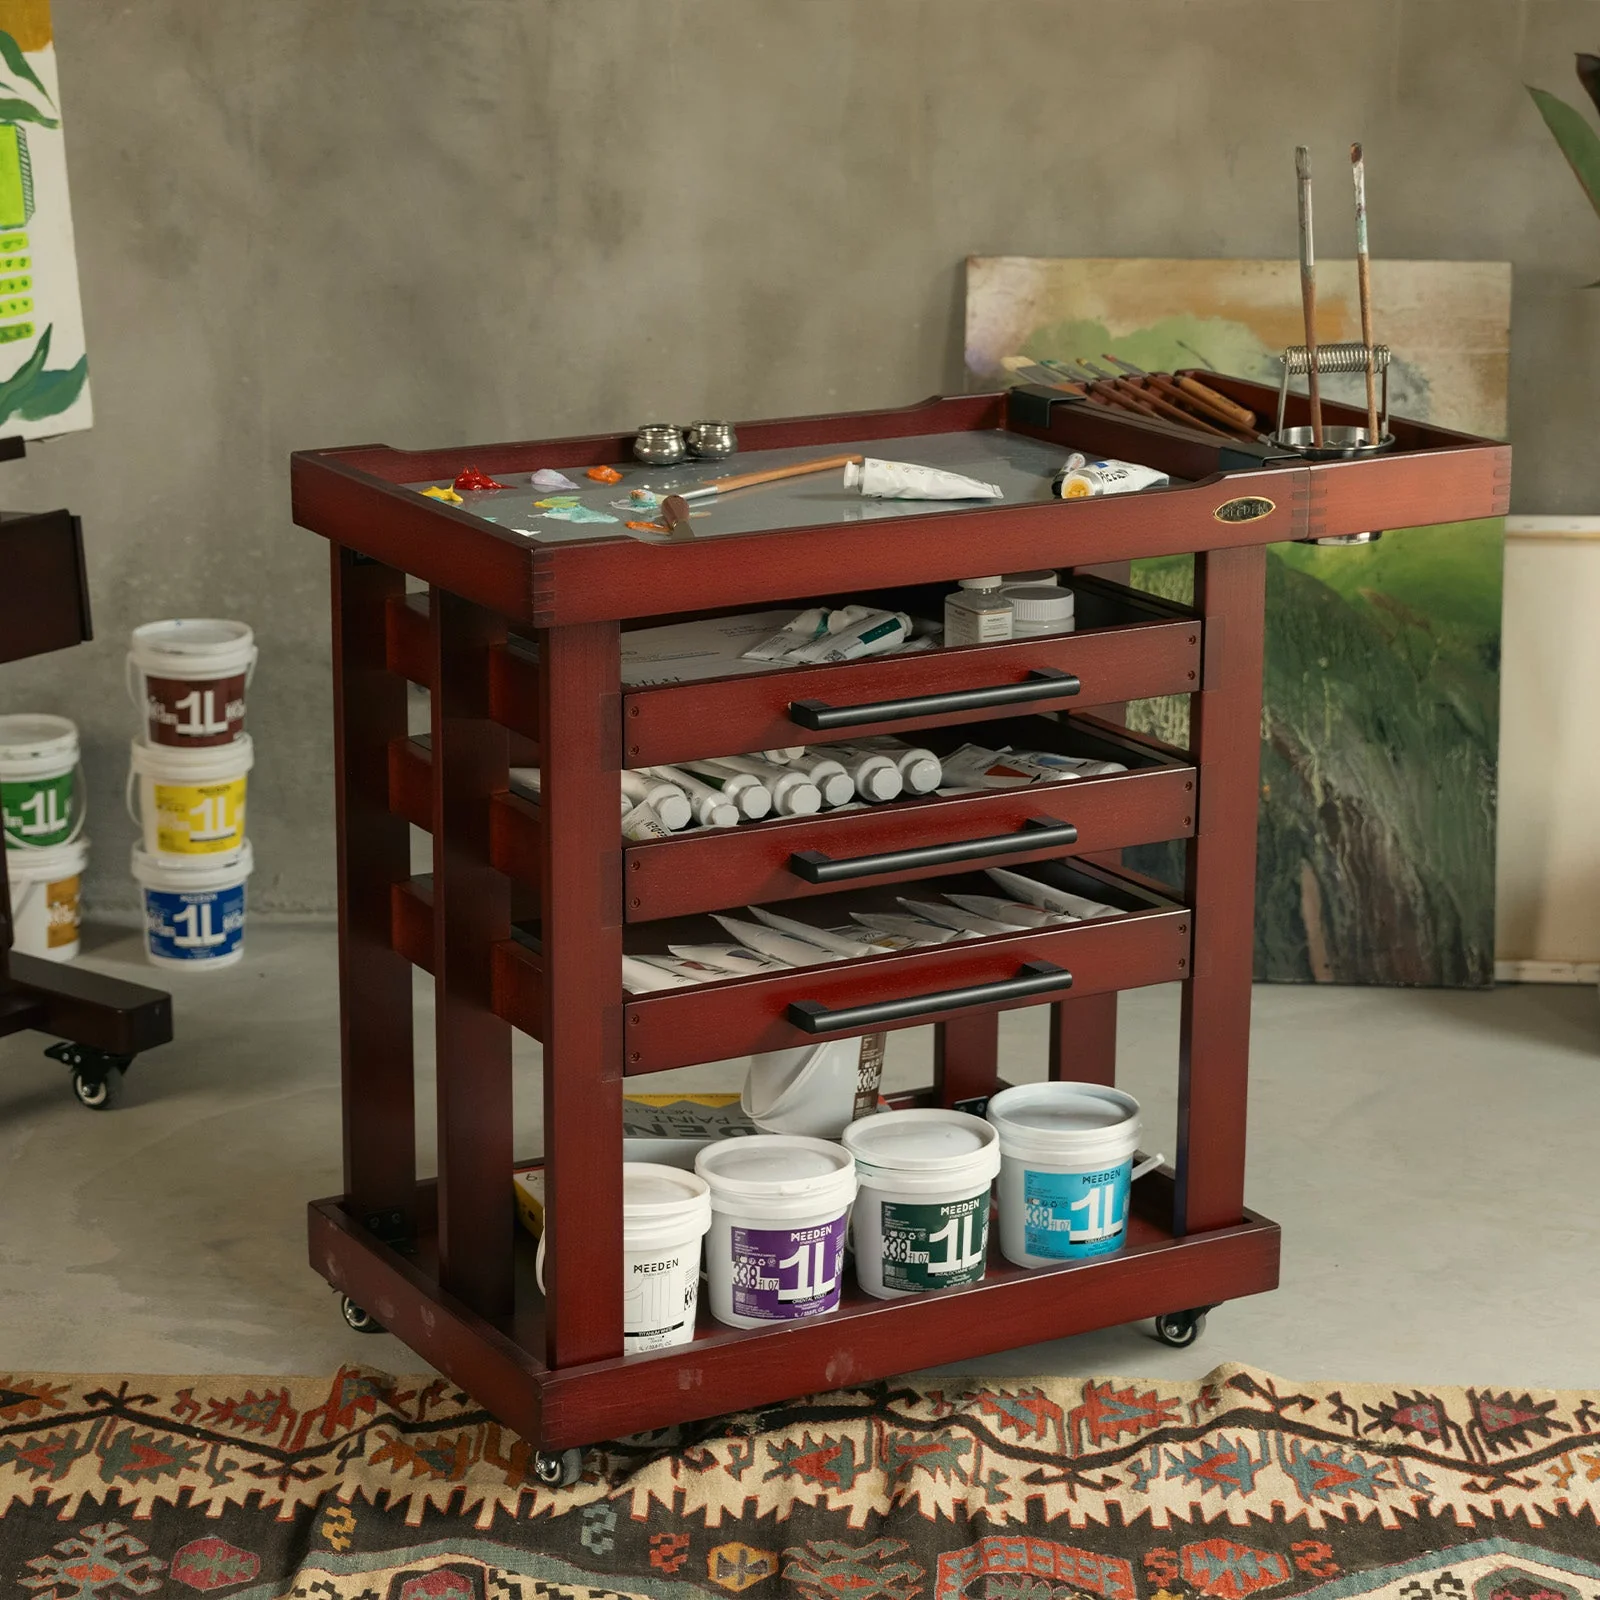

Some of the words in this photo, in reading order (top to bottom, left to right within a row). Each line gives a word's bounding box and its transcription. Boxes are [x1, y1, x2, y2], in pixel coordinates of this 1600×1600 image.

[175, 691, 228, 735] 1L
[21, 788, 67, 835] 1L
[189, 797, 236, 840] 1L
[173, 903, 227, 947] 1L
[654, 1115, 730, 1125] PAINT
[1082, 1168, 1120, 1185] MEEDEN
[940, 1199, 980, 1216] MEEDEN
[1069, 1183, 1123, 1241] 1L
[790, 1224, 832, 1242] MEEDEN
[927, 1214, 982, 1273] 1L
[633, 1257, 679, 1274] MEEDEN
[778, 1241, 836, 1300] 1L
